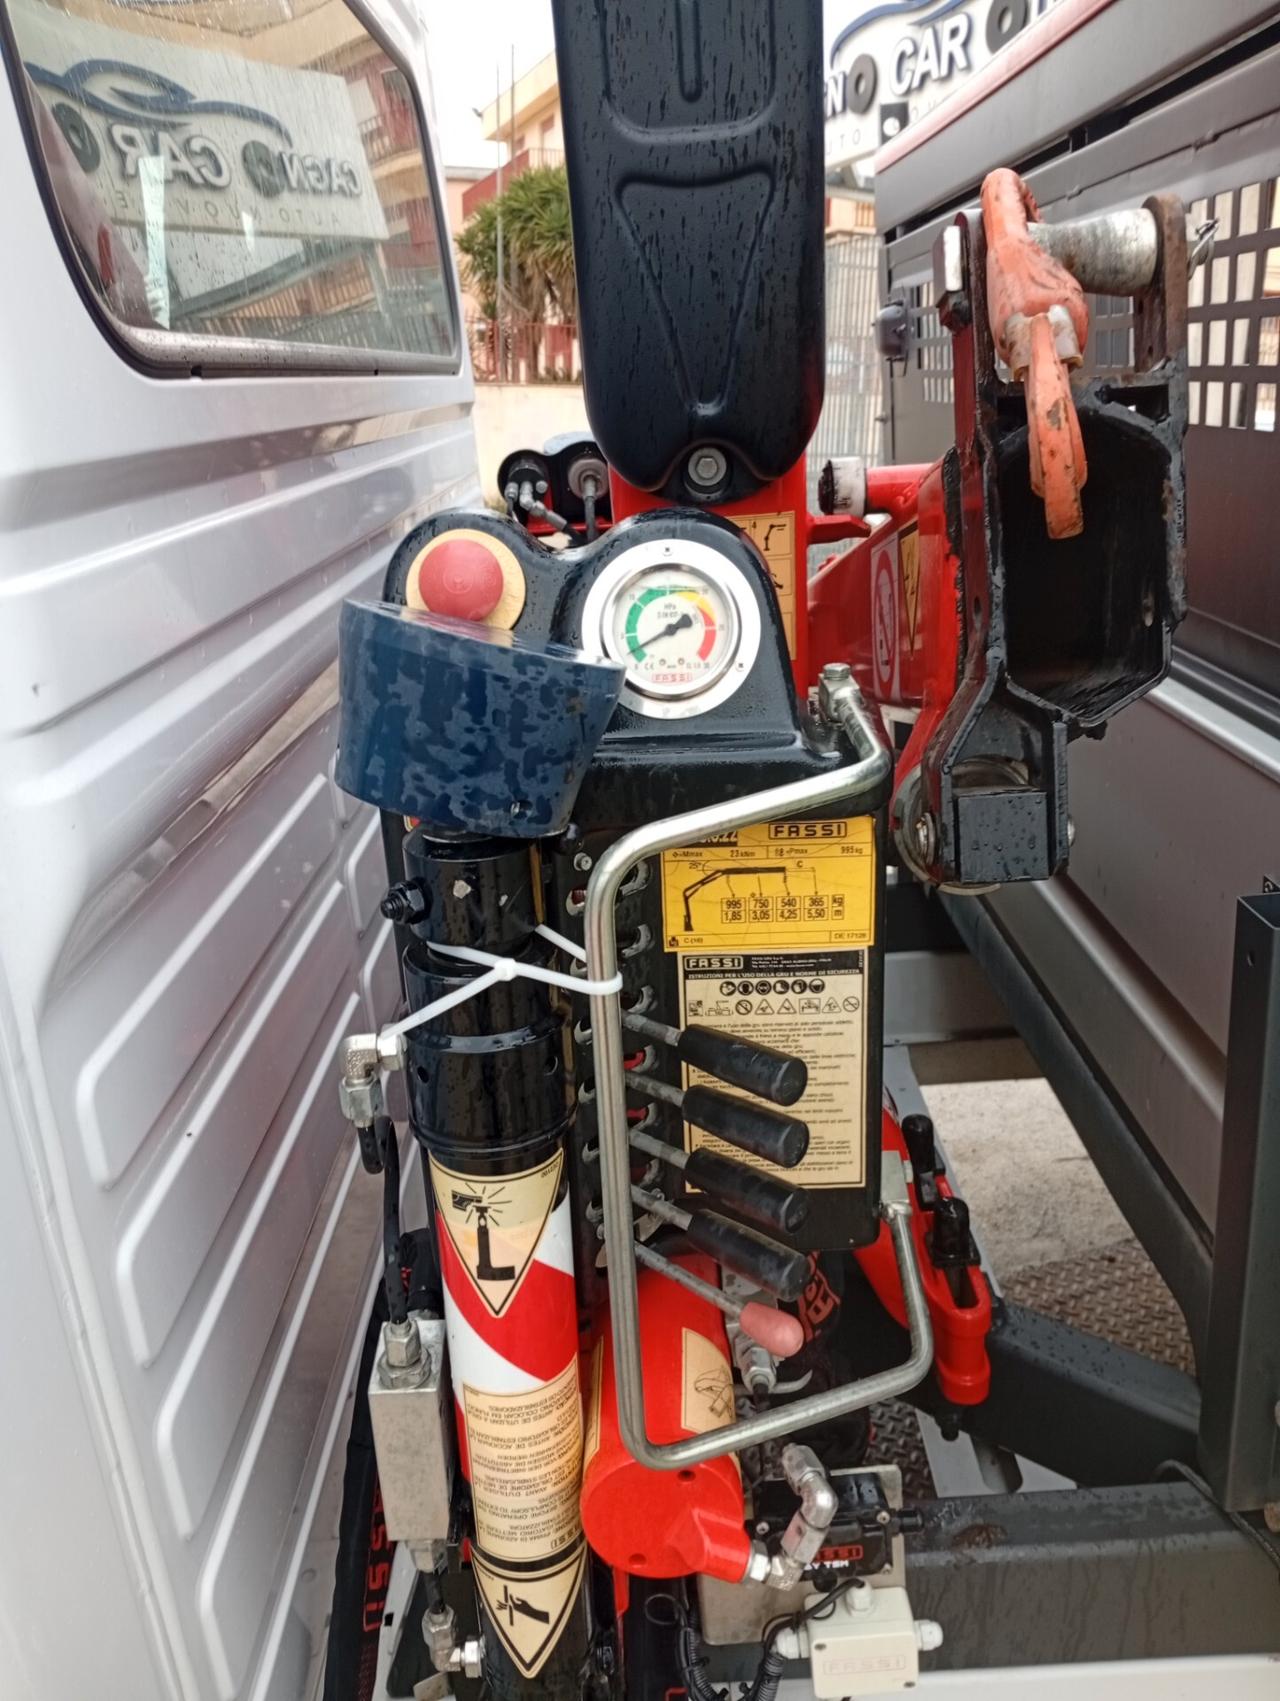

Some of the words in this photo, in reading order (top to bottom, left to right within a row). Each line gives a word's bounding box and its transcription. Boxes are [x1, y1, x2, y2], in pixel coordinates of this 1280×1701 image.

[889, 12, 974, 97] CAR
[773, 823, 842, 837] FASSI
[796, 860, 804, 868] C
[726, 900, 742, 909] 995
[753, 899, 769, 908] 750
[781, 898, 797, 907] 540
[809, 897, 824, 906] 365
[724, 911, 742, 922] 1,85
[752, 910, 770, 921] 3,05
[779, 910, 798, 920] 4,25
[807, 909, 825, 919] 5,50
[689, 957, 739, 969] FASSI
